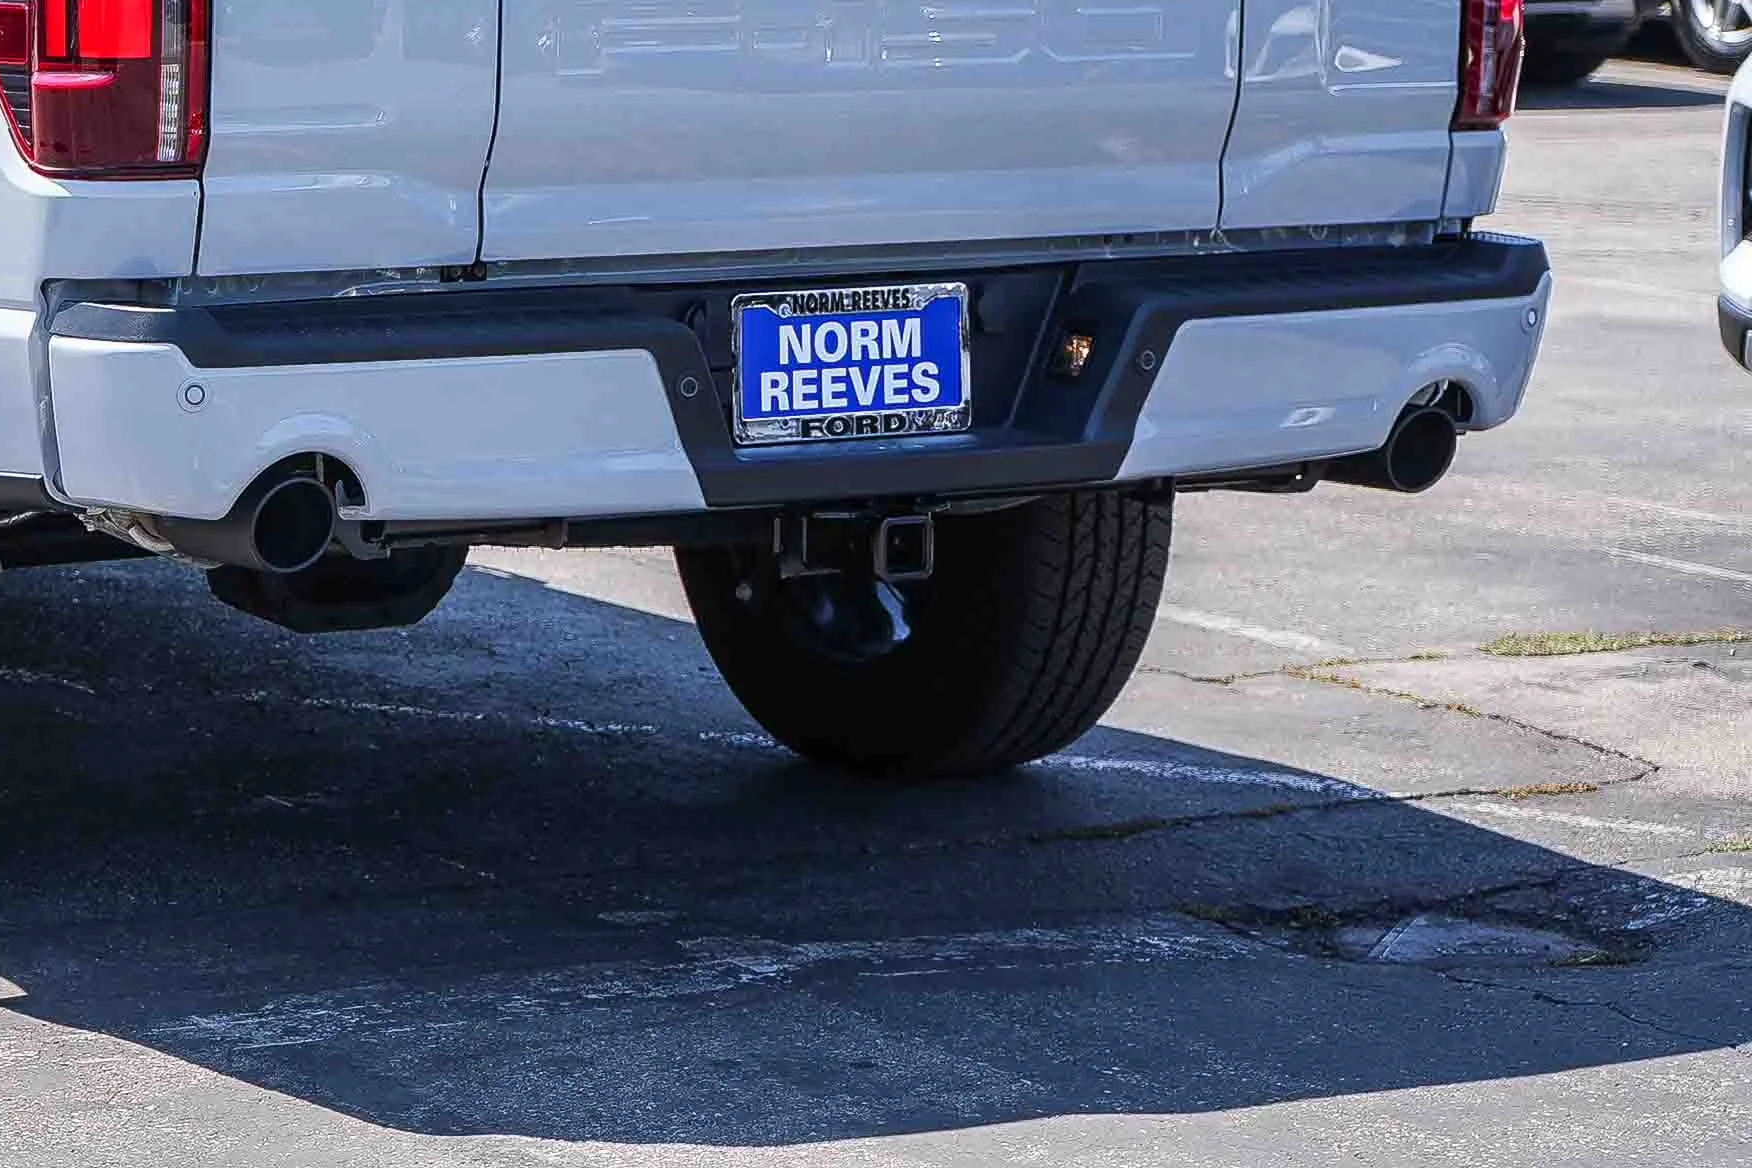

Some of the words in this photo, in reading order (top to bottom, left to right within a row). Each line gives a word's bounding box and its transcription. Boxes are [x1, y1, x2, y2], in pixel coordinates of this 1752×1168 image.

[851, 288, 911, 311] REEVES
[778, 317, 922, 365] NORM
[760, 361, 941, 413] REEVES
[800, 412, 910, 438] FORD
